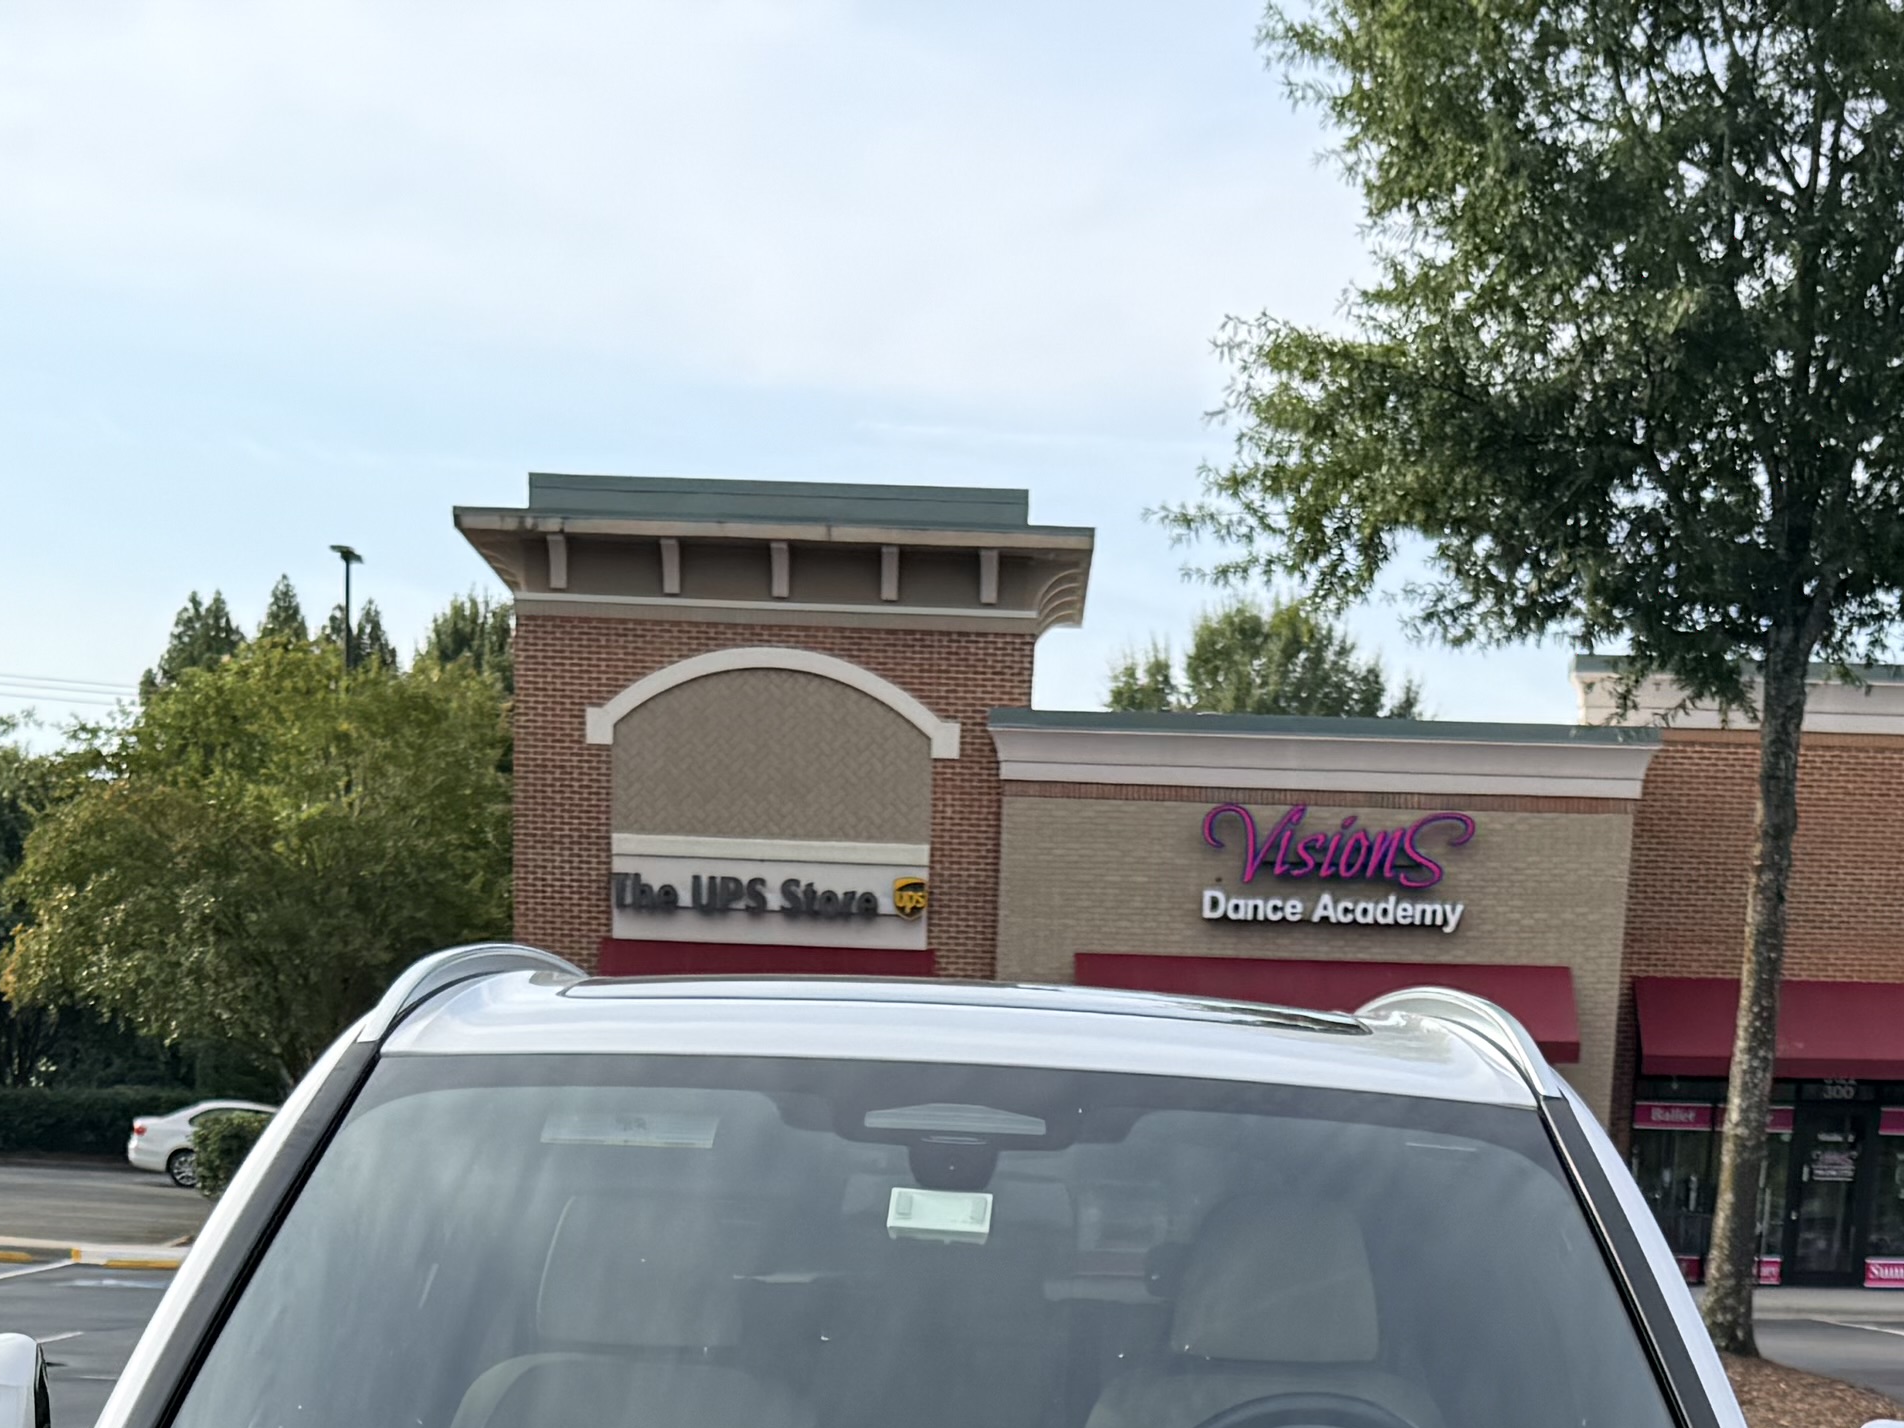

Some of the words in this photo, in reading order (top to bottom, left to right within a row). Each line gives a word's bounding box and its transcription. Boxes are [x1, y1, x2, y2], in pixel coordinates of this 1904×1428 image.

[613, 872, 678, 911] The
[692, 875, 767, 913] UPS
[781, 878, 879, 915] Store
[895, 890, 926, 914] ups
[1202, 889, 1303, 921] Dance
[1312, 893, 1464, 933] Academy
[1823, 1085, 1855, 1099] 300
[1651, 1107, 1696, 1122] Ballet
